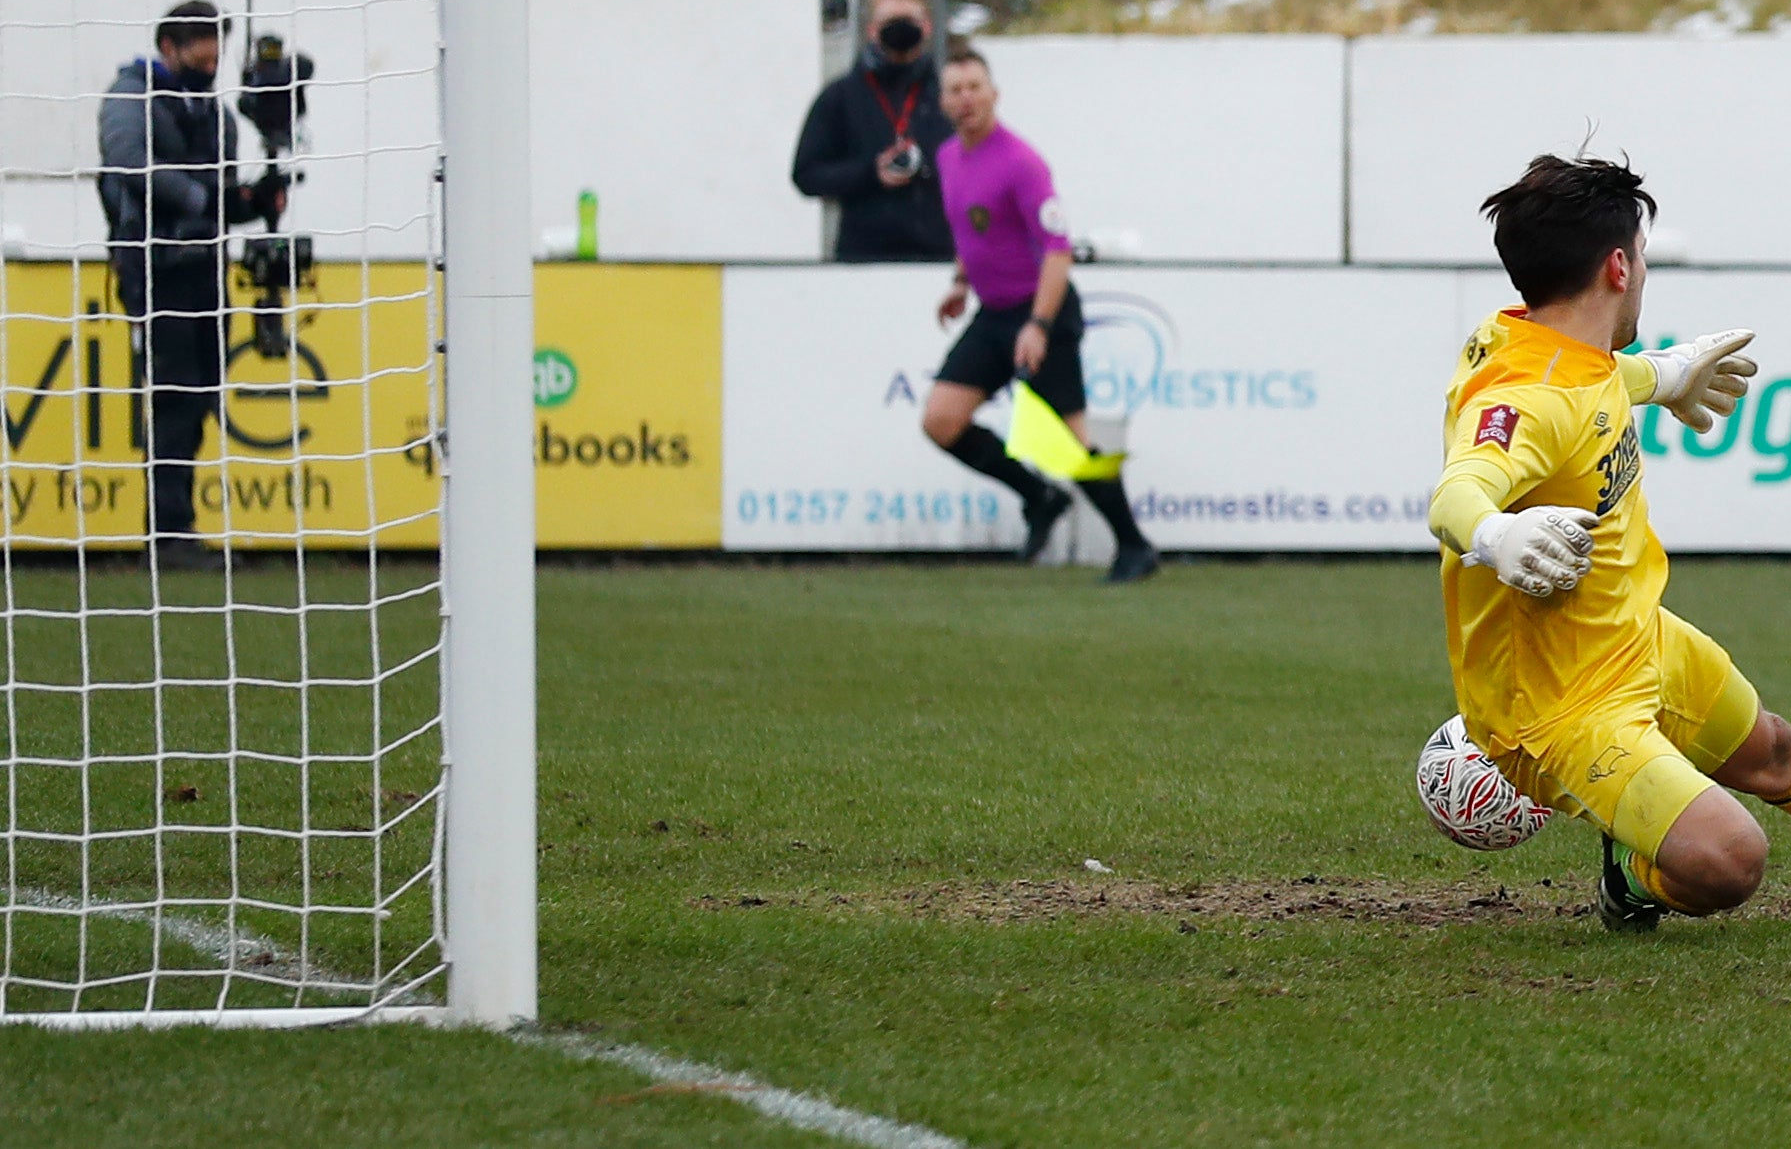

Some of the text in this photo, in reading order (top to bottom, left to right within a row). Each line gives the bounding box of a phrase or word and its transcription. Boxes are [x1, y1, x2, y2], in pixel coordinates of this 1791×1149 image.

[1086, 370, 1318, 409] OMESTICS
[56, 470, 126, 512] for
[738, 489, 999, 525] 01257 241619
